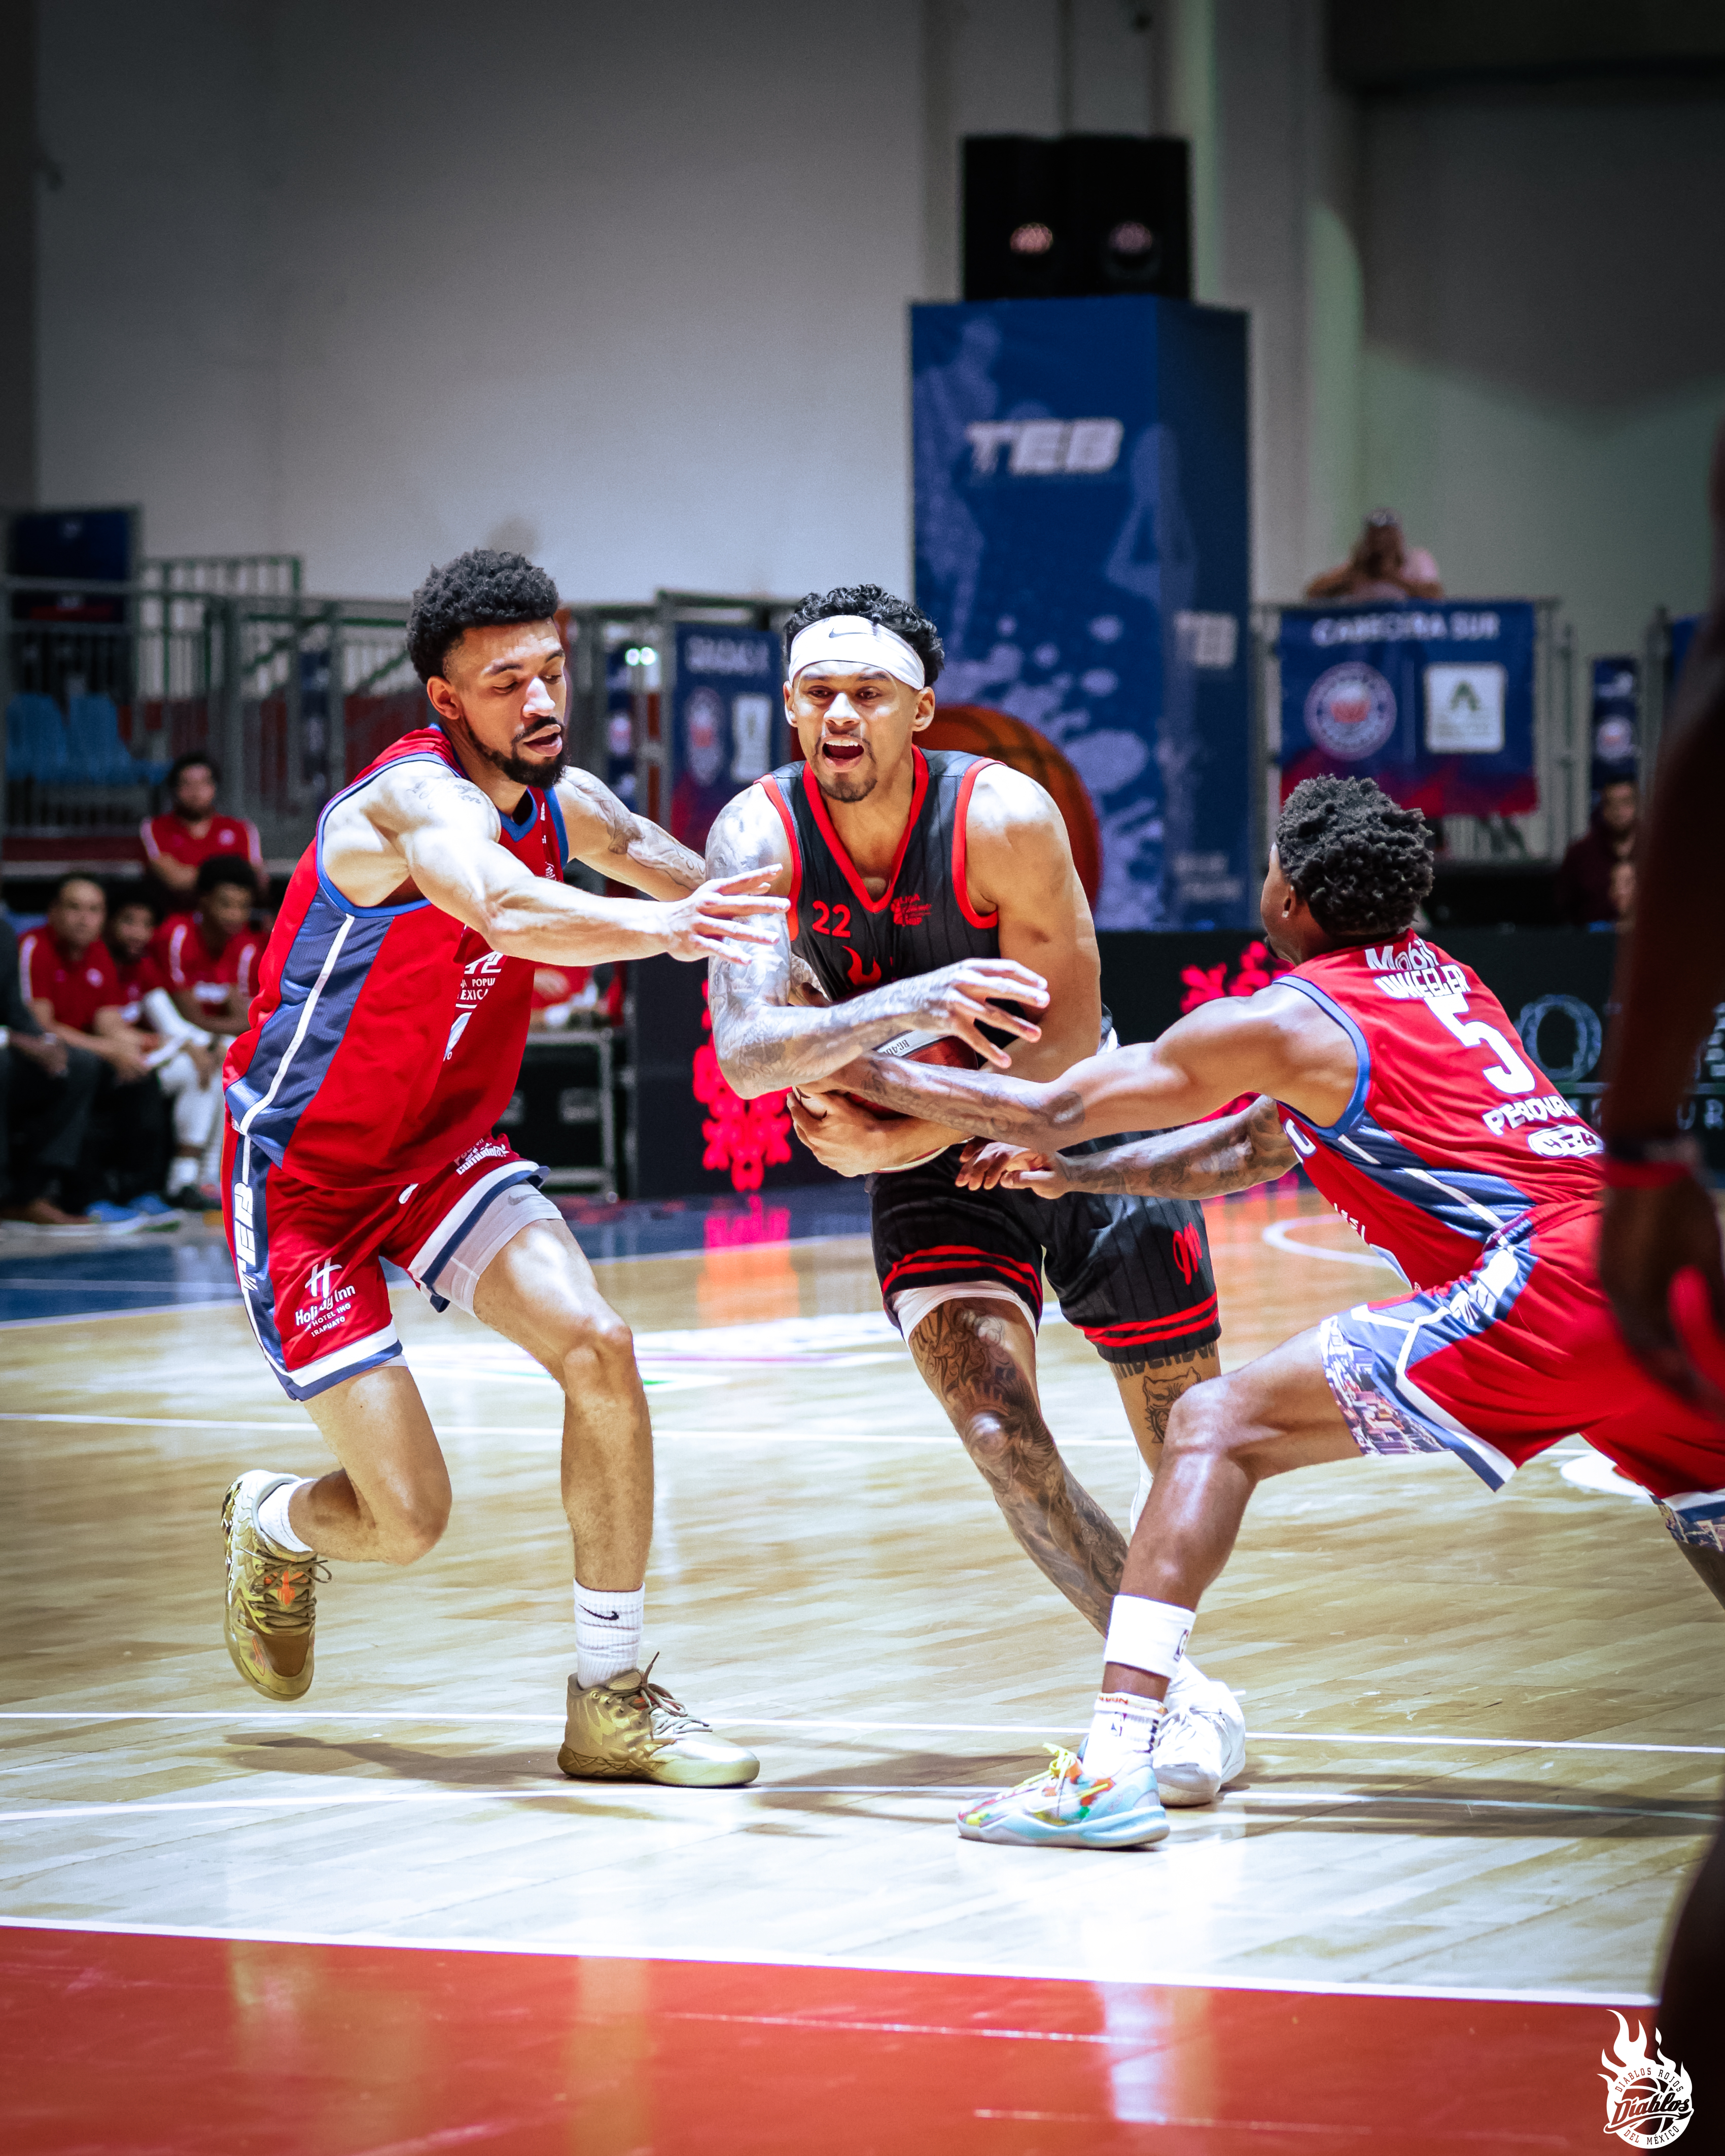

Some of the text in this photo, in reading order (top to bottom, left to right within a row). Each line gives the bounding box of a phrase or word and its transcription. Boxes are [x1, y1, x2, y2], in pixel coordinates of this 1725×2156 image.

[812, 900, 851, 938] 22
[1364, 938, 1439, 970] Mobil
[1373, 964, 1471, 999] WHEELER
[1423, 992, 1536, 1094] 5
[334, 1285, 356, 1302] Inn
[310, 1316, 346, 1337] IRAPUATO
[312, 1311, 336, 1327] HOTEL
